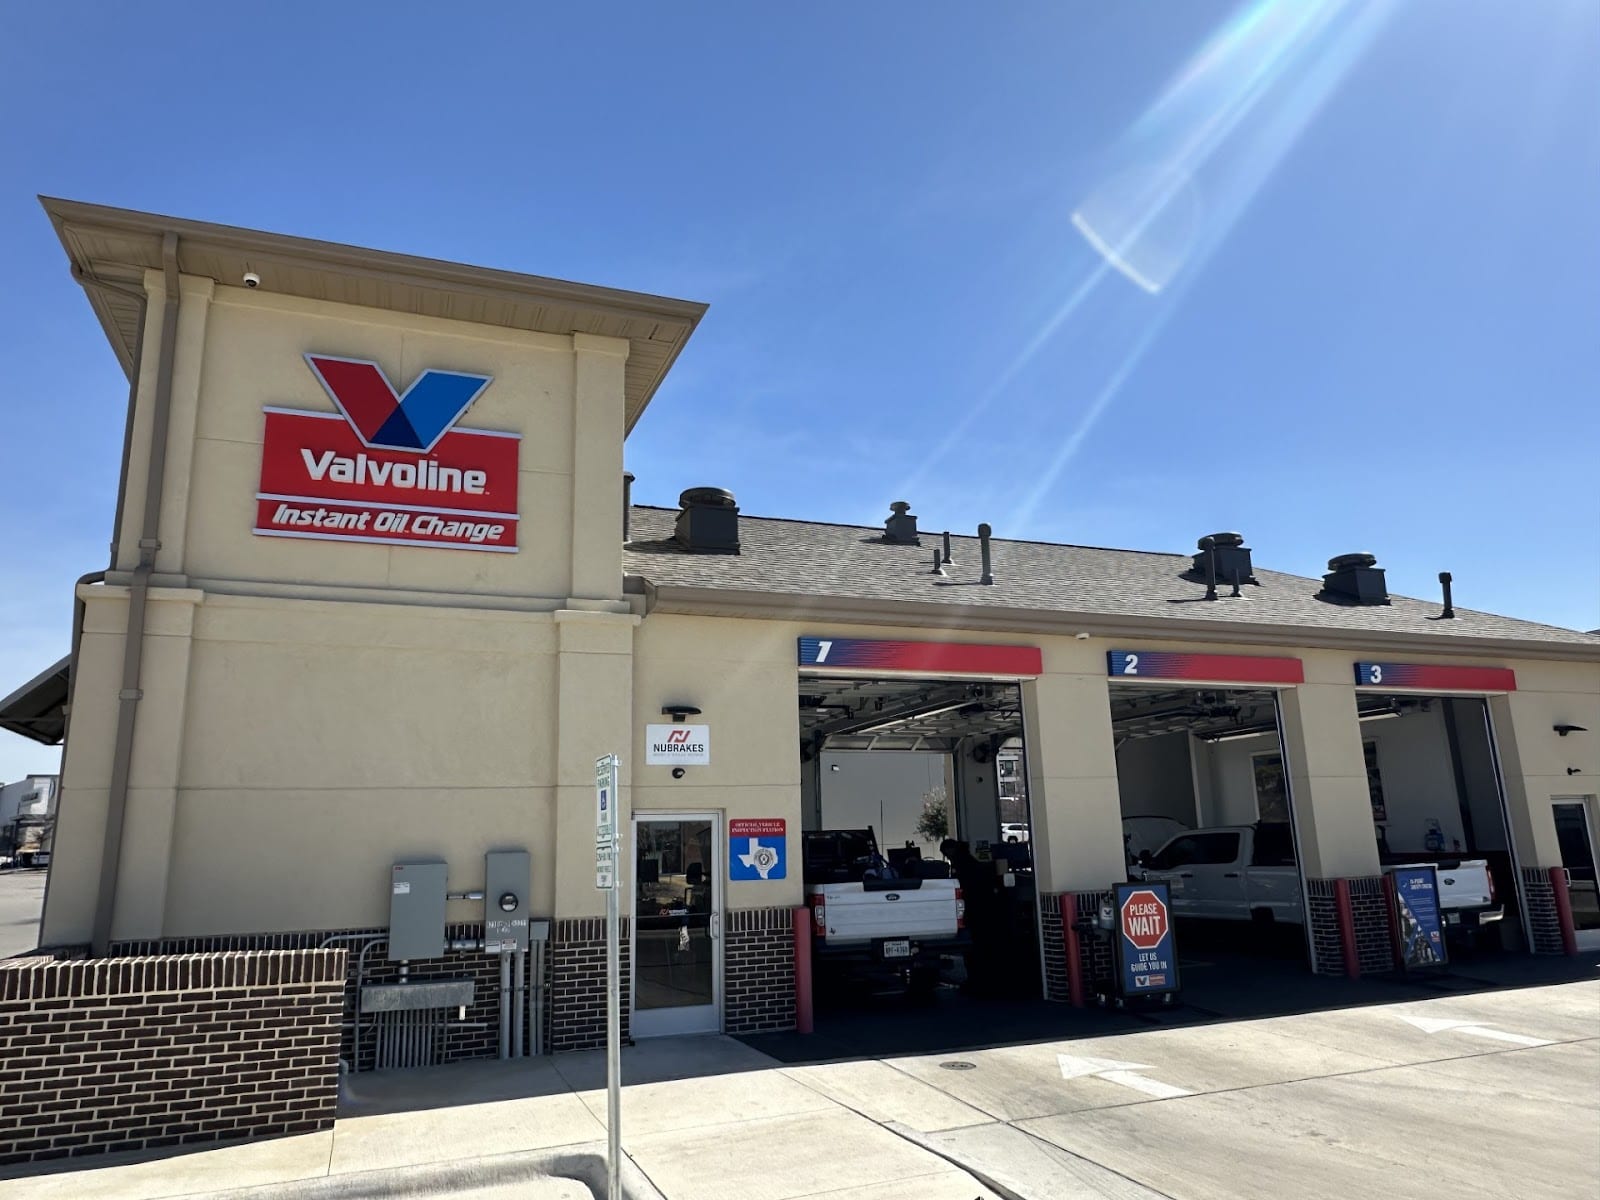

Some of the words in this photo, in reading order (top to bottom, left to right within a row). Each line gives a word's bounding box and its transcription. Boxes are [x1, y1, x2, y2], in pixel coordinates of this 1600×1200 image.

[300, 448, 487, 495] Valvoline
[271, 504, 370, 530] Instant
[373, 511, 408, 533] Oil
[411, 515, 505, 543] Change
[815, 641, 832, 663] 1
[1124, 654, 1139, 675] 2
[1370, 665, 1382, 684] 3
[653, 743, 704, 753] NUBRAKES
[1130, 903, 1158, 916] PLEASE
[1128, 916, 1161, 937] WAIT
[1130, 962, 1148, 972] GUIDE
[1148, 961, 1160, 971] YOU
[1139, 953, 1148, 962] LET
[1150, 952, 1157, 961] US
